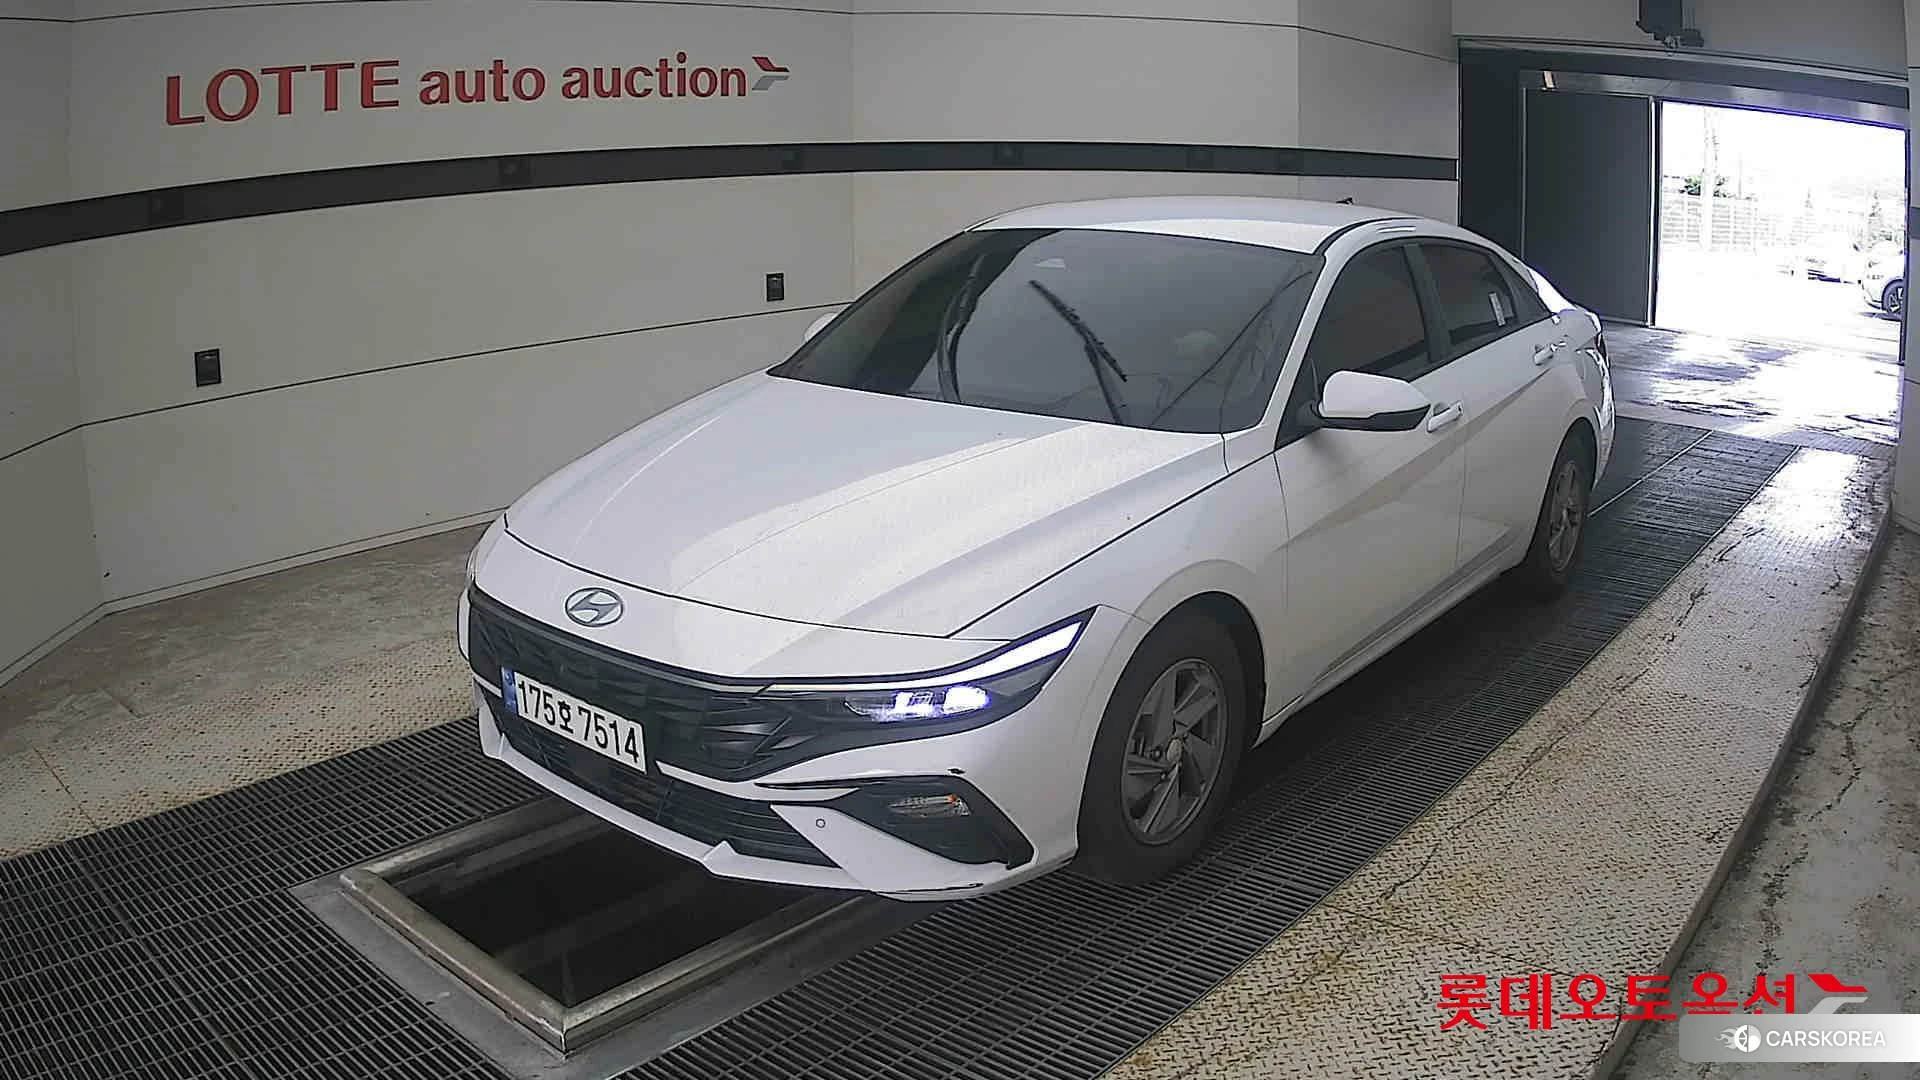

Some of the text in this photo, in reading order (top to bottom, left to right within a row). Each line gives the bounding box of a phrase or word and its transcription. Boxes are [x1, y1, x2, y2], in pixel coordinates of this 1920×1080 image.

[165, 51, 748, 126] LOTTE auto auction
[518, 680, 640, 763] 175호 7514
